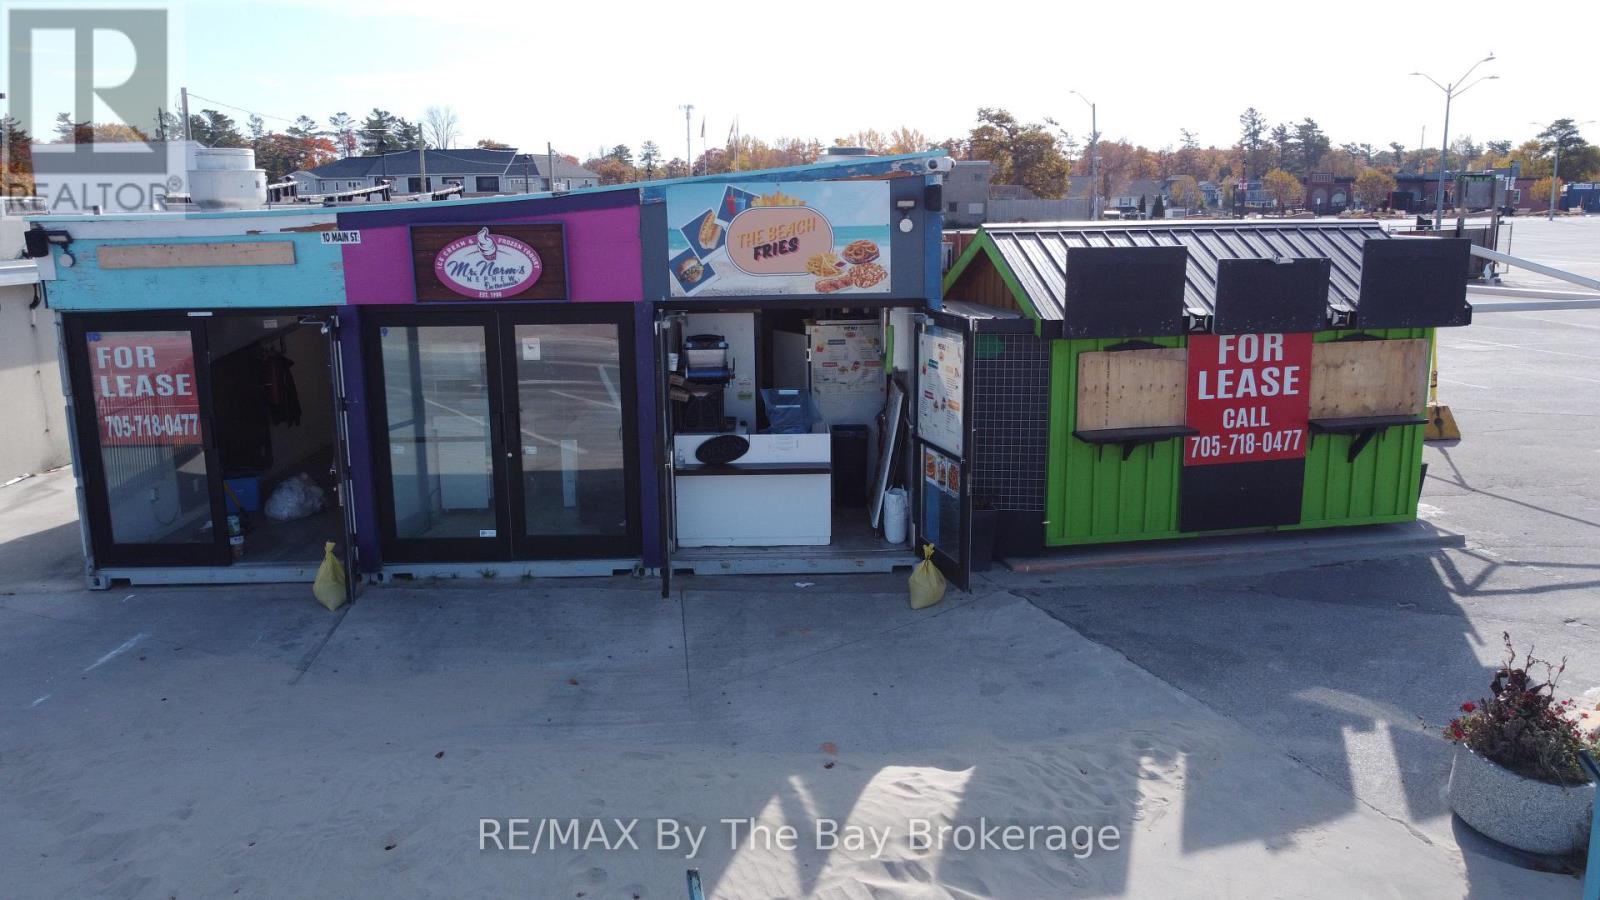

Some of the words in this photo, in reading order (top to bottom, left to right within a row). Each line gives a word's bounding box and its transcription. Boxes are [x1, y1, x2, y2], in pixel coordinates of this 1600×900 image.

[322, 232, 330, 242] 10
[332, 232, 349, 242] MAIN
[350, 232, 358, 241] ST
[737, 229, 765, 248] THE
[768, 217, 816, 241] BEACH
[443, 241, 466, 257] CREAM
[498, 238, 523, 250] FROZEN
[753, 237, 799, 261] FRIES
[476, 261, 525, 277] Norm's
[96, 346, 156, 368] FOR
[1218, 333, 1284, 364] FOR
[100, 374, 193, 397] LEASE
[1198, 366, 1300, 400] LEASE
[104, 413, 198, 438] 705-718-0477
[1222, 406, 1270, 429] CALL
[1191, 429, 1302, 458] 705-718-0477
